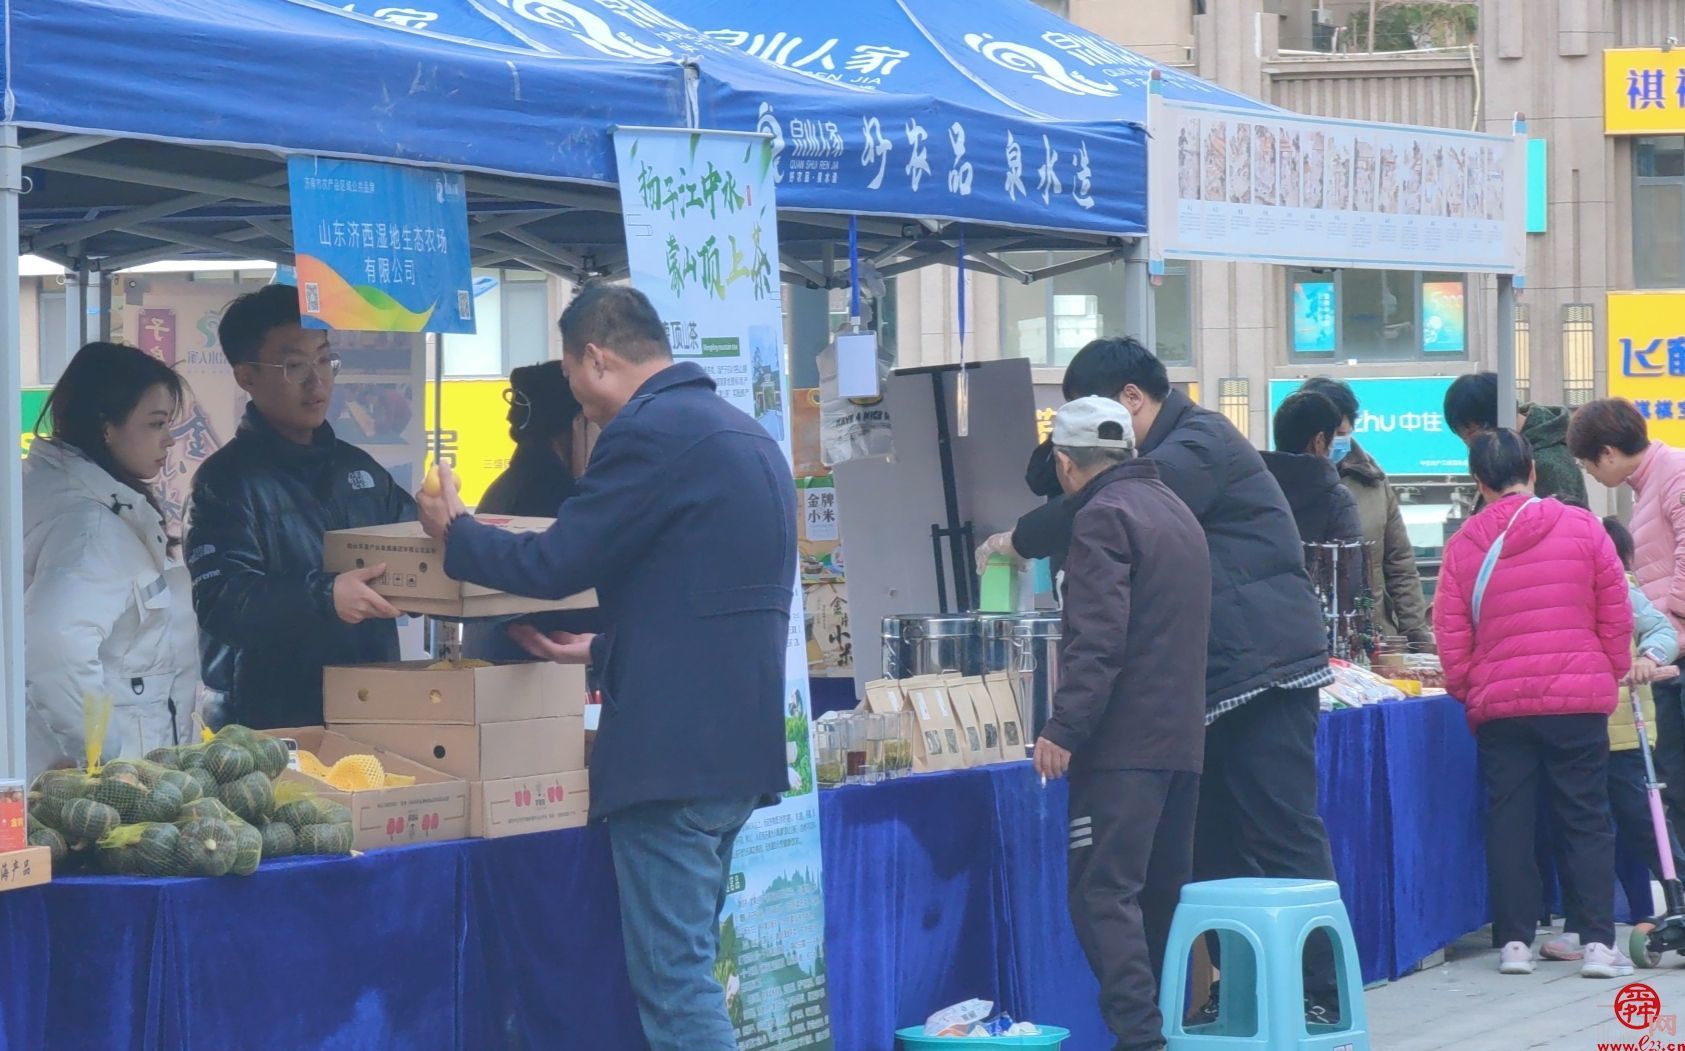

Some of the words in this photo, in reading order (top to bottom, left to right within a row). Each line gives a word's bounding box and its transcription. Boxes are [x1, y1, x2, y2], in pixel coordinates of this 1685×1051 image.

[850, 76, 881, 85] JIA
[861, 115, 974, 196] 好农品
[1003, 129, 1095, 210] 泉水造
[637, 160, 746, 221] 扬子江中水
[318, 219, 448, 254] 山东济西湿地生态农场
[364, 256, 416, 286] 有限公司
[1399, 411, 1443, 433] 中住
[808, 493, 835, 509] 金牌
[807, 509, 836, 524] 小米
